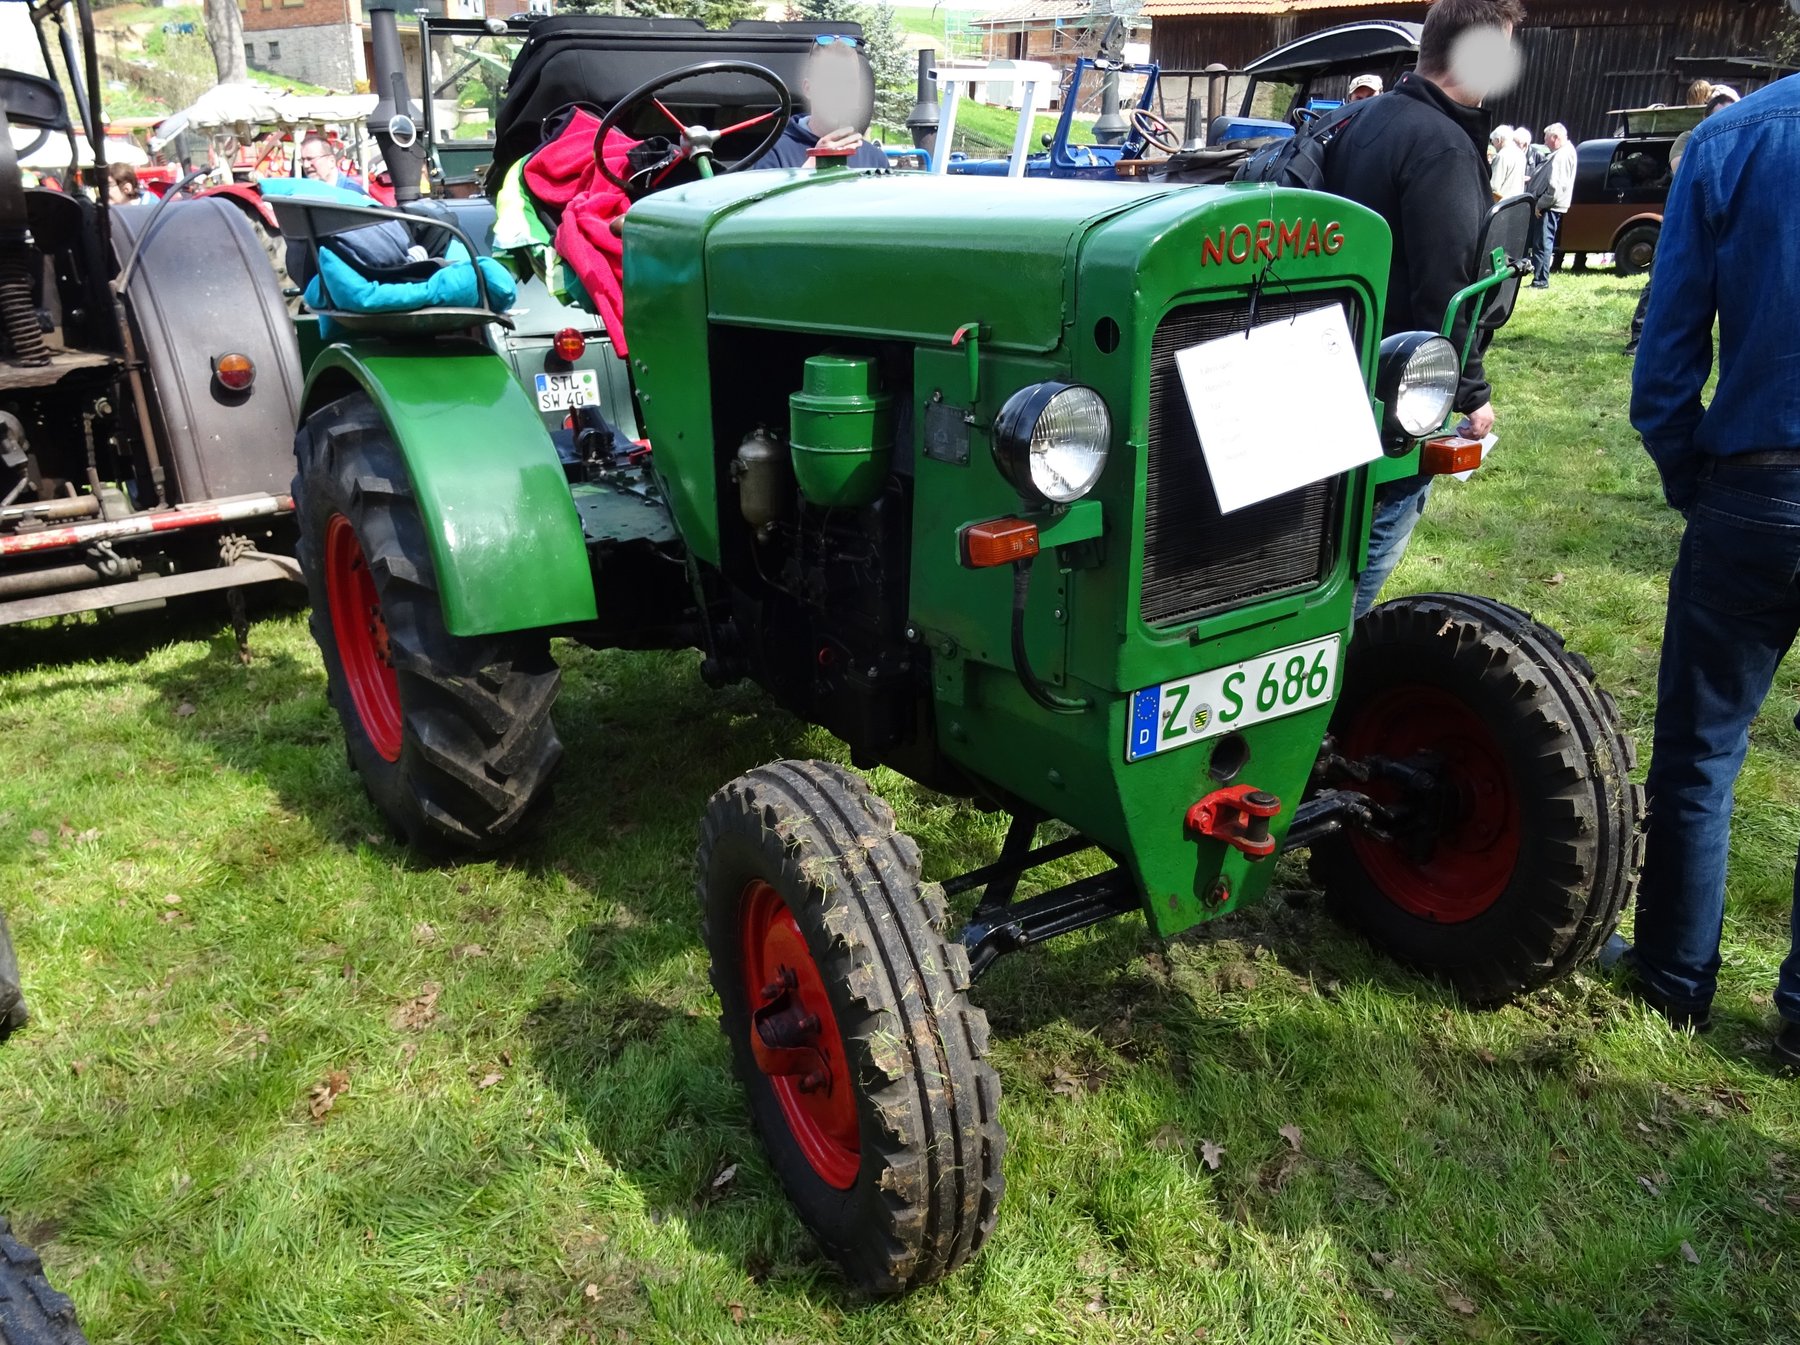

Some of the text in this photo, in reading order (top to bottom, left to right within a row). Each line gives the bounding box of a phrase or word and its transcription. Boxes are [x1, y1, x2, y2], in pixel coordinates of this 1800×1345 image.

[1200, 216, 1345, 266] NORMAG
[550, 375, 579, 391] STL
[542, 393, 560, 409] SW
[1161, 648, 1329, 741] Z S 686
[1139, 728, 1150, 745] D
